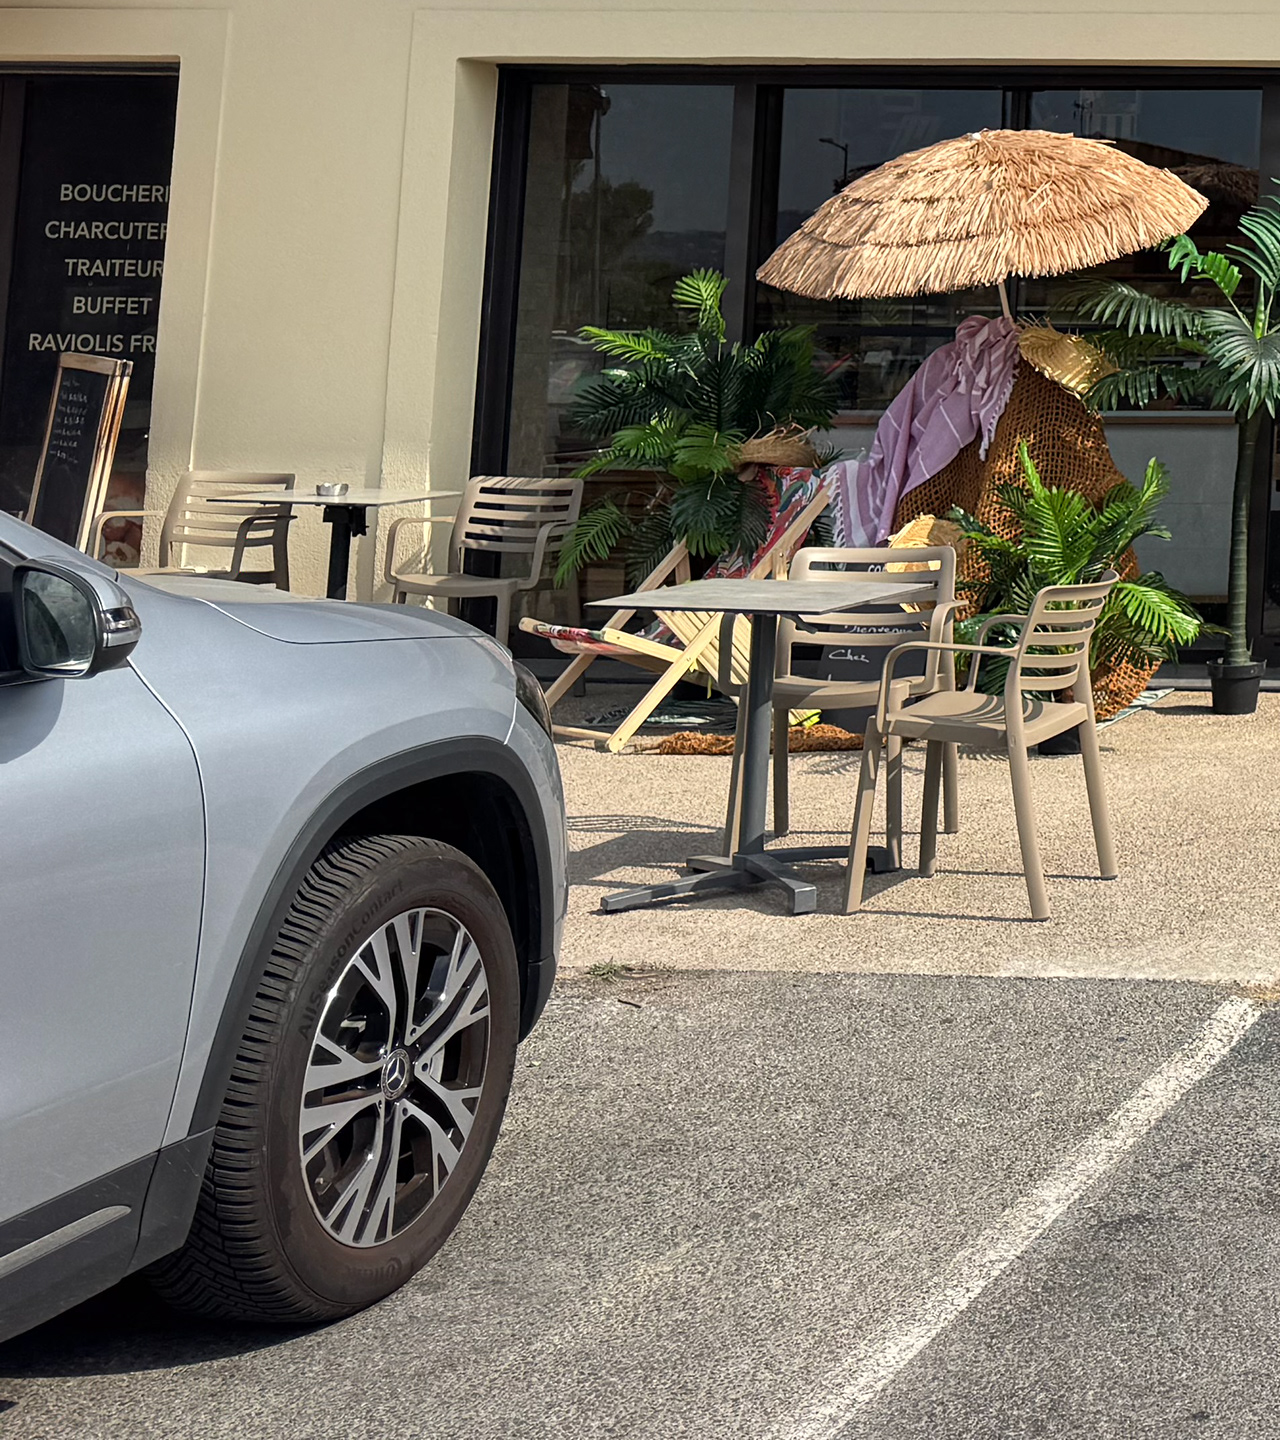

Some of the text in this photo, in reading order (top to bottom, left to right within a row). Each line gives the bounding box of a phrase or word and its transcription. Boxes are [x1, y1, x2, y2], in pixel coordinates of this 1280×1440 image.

[59, 183, 169, 204] BOUCHERI
[64, 257, 163, 278] TRAITEUR
[73, 296, 152, 316] BUFFET
[28, 333, 157, 354] RAVIOLIS FR
[828, 649, 869, 663] Chez
